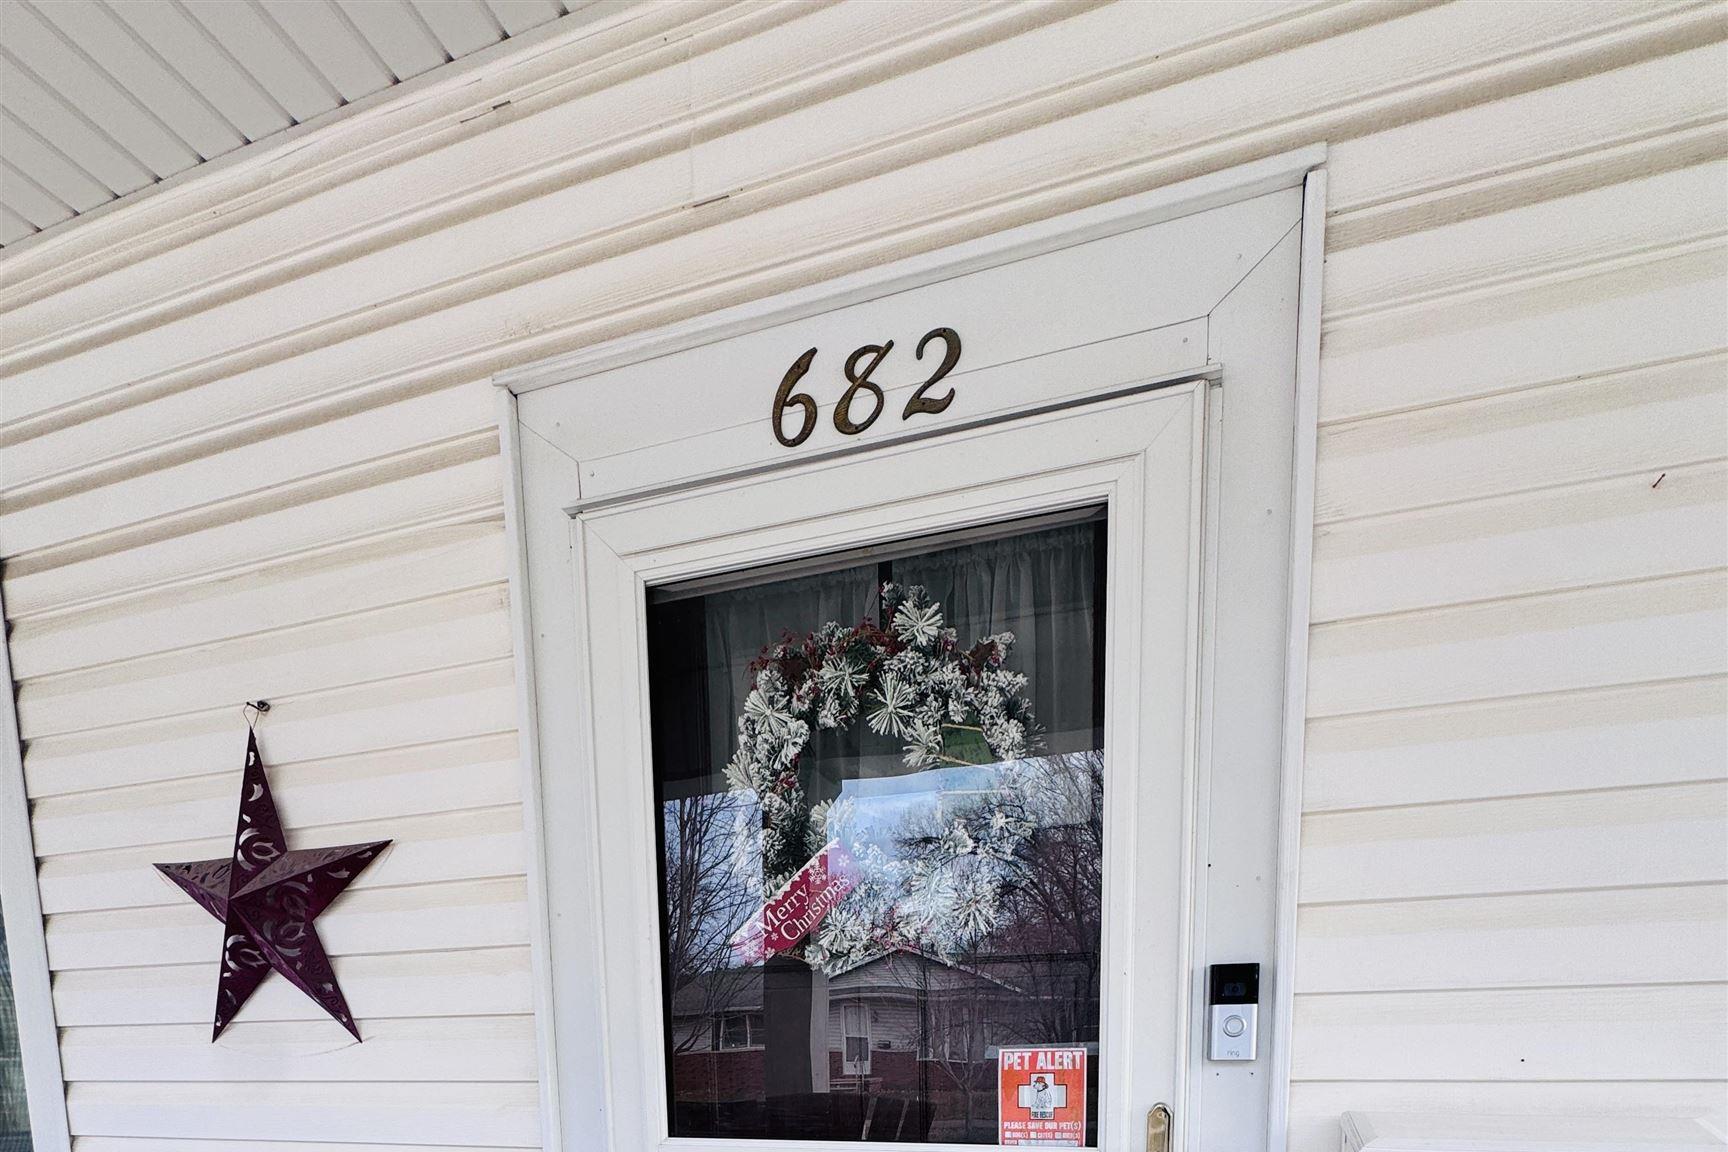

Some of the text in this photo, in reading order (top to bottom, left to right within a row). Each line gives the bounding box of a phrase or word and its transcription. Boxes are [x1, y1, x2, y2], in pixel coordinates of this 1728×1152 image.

[772, 327, 962, 447] 682
[755, 883, 810, 938] Merry
[781, 875, 850, 940] Christmas
[1003, 1051, 1083, 1070] PET ALERT
[1227, 1050, 1240, 1058] ring
[1059, 1122, 1082, 1130] PET(S)
